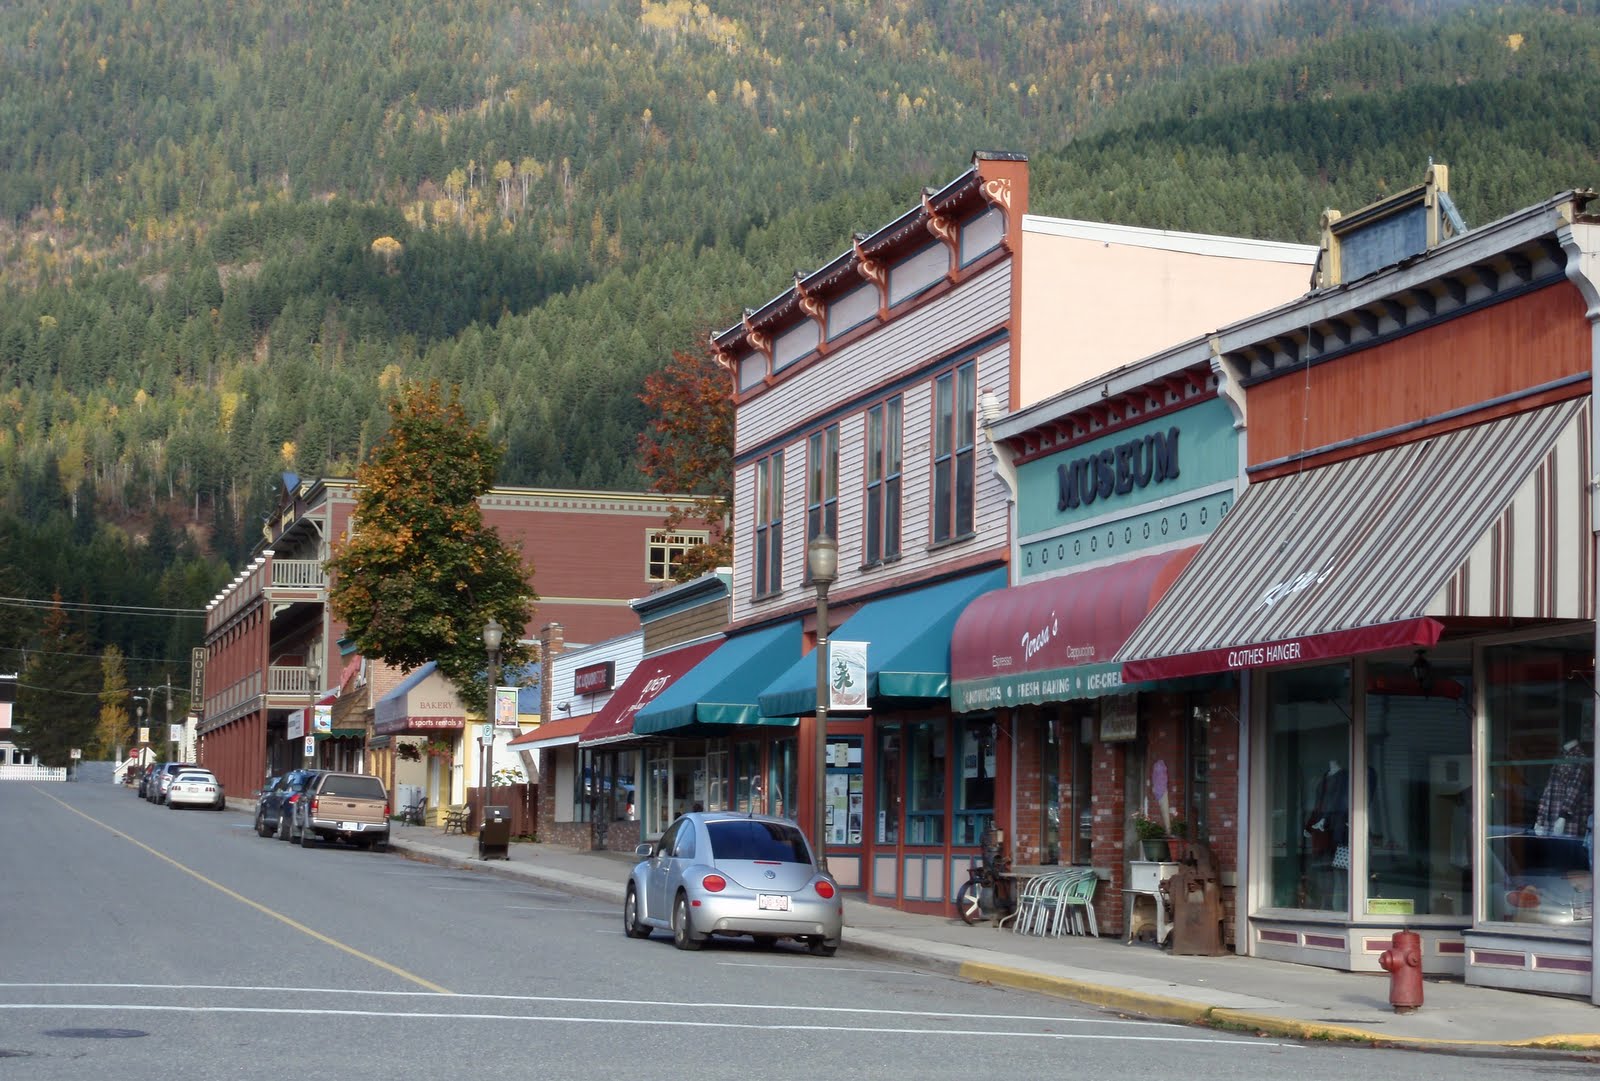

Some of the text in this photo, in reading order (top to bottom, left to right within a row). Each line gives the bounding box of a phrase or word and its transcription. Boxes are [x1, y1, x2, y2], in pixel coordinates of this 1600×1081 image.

[1057, 426, 1181, 512] MUSEUM
[992, 655, 1013, 669] Espresso
[1066, 643, 1095, 660] Cappuccino
[1228, 642, 1301, 667] CLOTHES HANGER
[194, 651, 204, 696] HOTEL
[1017, 681, 1040, 698] FRESH
[1042, 677, 1070, 696] BAKING
[1087, 671, 1123, 690] ICE-CREA
[420, 701, 453, 709] BAKERY
[415, 718, 457, 728] sports rentals
